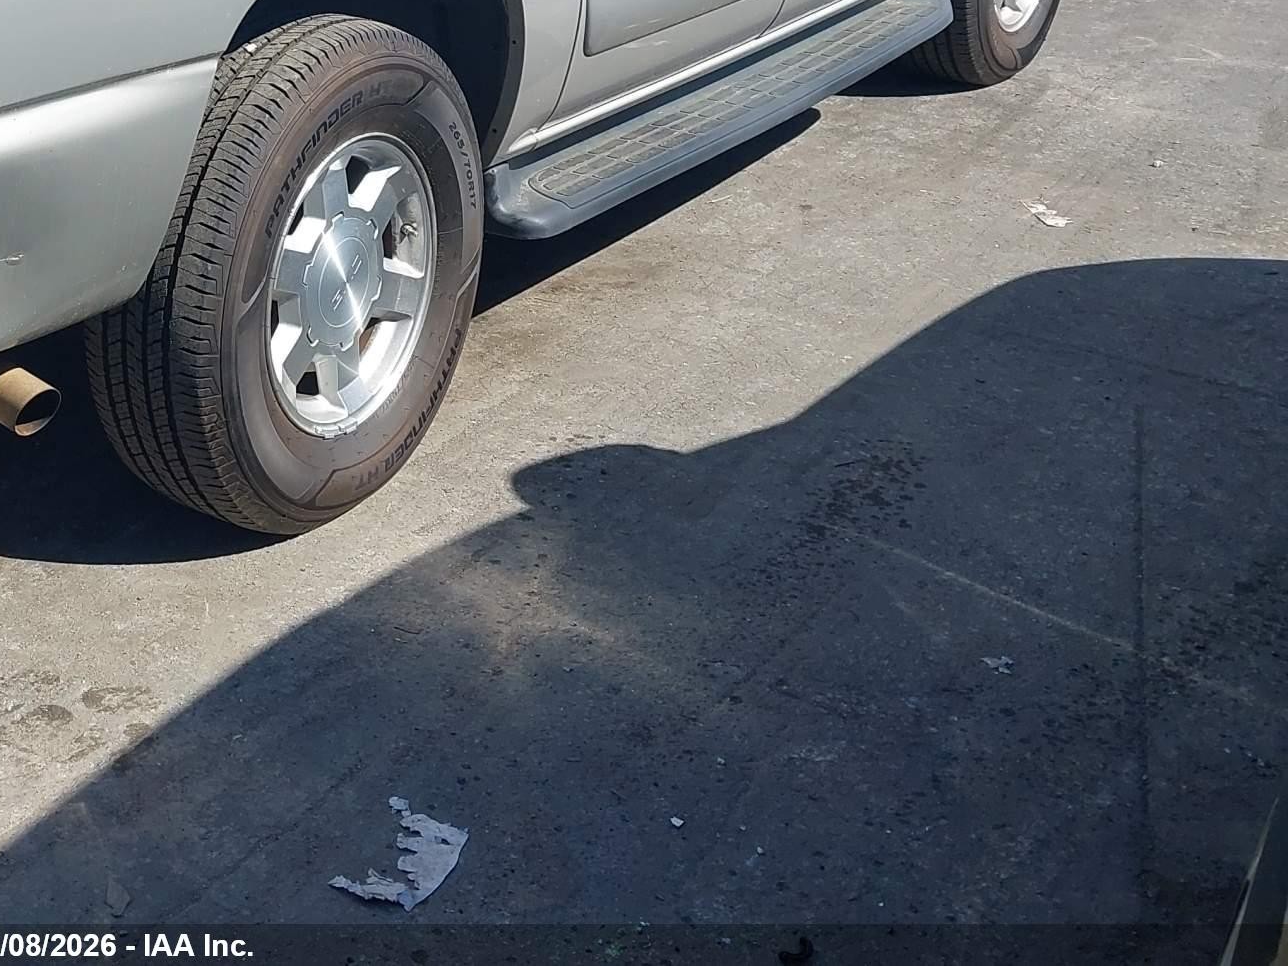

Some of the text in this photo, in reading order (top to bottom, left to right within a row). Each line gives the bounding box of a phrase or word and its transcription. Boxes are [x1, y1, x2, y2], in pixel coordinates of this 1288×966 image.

[264, 91, 364, 239] PATHFINDER
[448, 121, 477, 209] 265/70R17
[383, 328, 462, 472] PATHFINDER
[355, 465, 379, 491] HT
